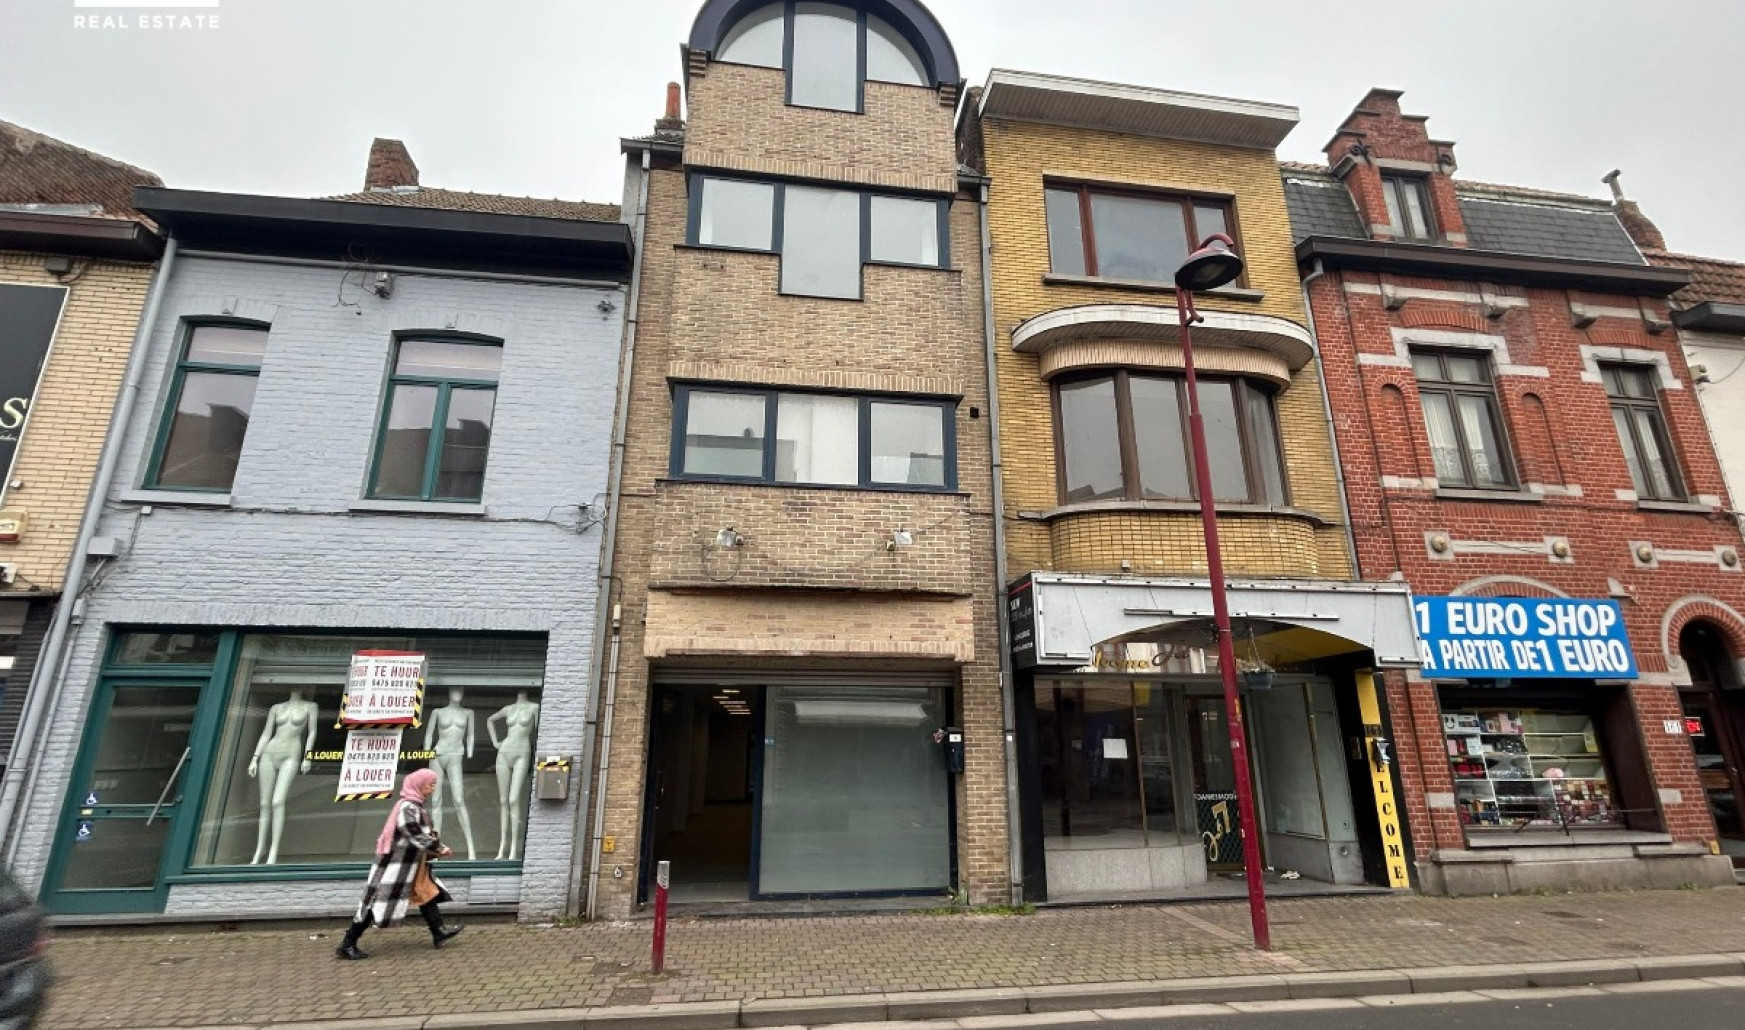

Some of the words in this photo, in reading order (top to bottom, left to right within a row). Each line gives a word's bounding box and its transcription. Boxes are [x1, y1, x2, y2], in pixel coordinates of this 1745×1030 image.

[1416, 601, 1431, 634] 1
[1447, 601, 1528, 636] EURO
[1535, 604, 1616, 636] SHOP
[1439, 639, 1510, 670] PARTIR
[1557, 639, 1629, 673] EURO
[374, 665, 387, 677] TE
[391, 666, 419, 678] HUUR
[380, 696, 416, 708] LOUER
[351, 738, 364, 751] TE
[367, 738, 397, 752] HUUR
[306, 751, 313, 760] A
[314, 751, 343, 760] LOUER
[399, 751, 406, 760] A
[407, 751, 436, 760] LOUER
[355, 769, 392, 782] LOUER
